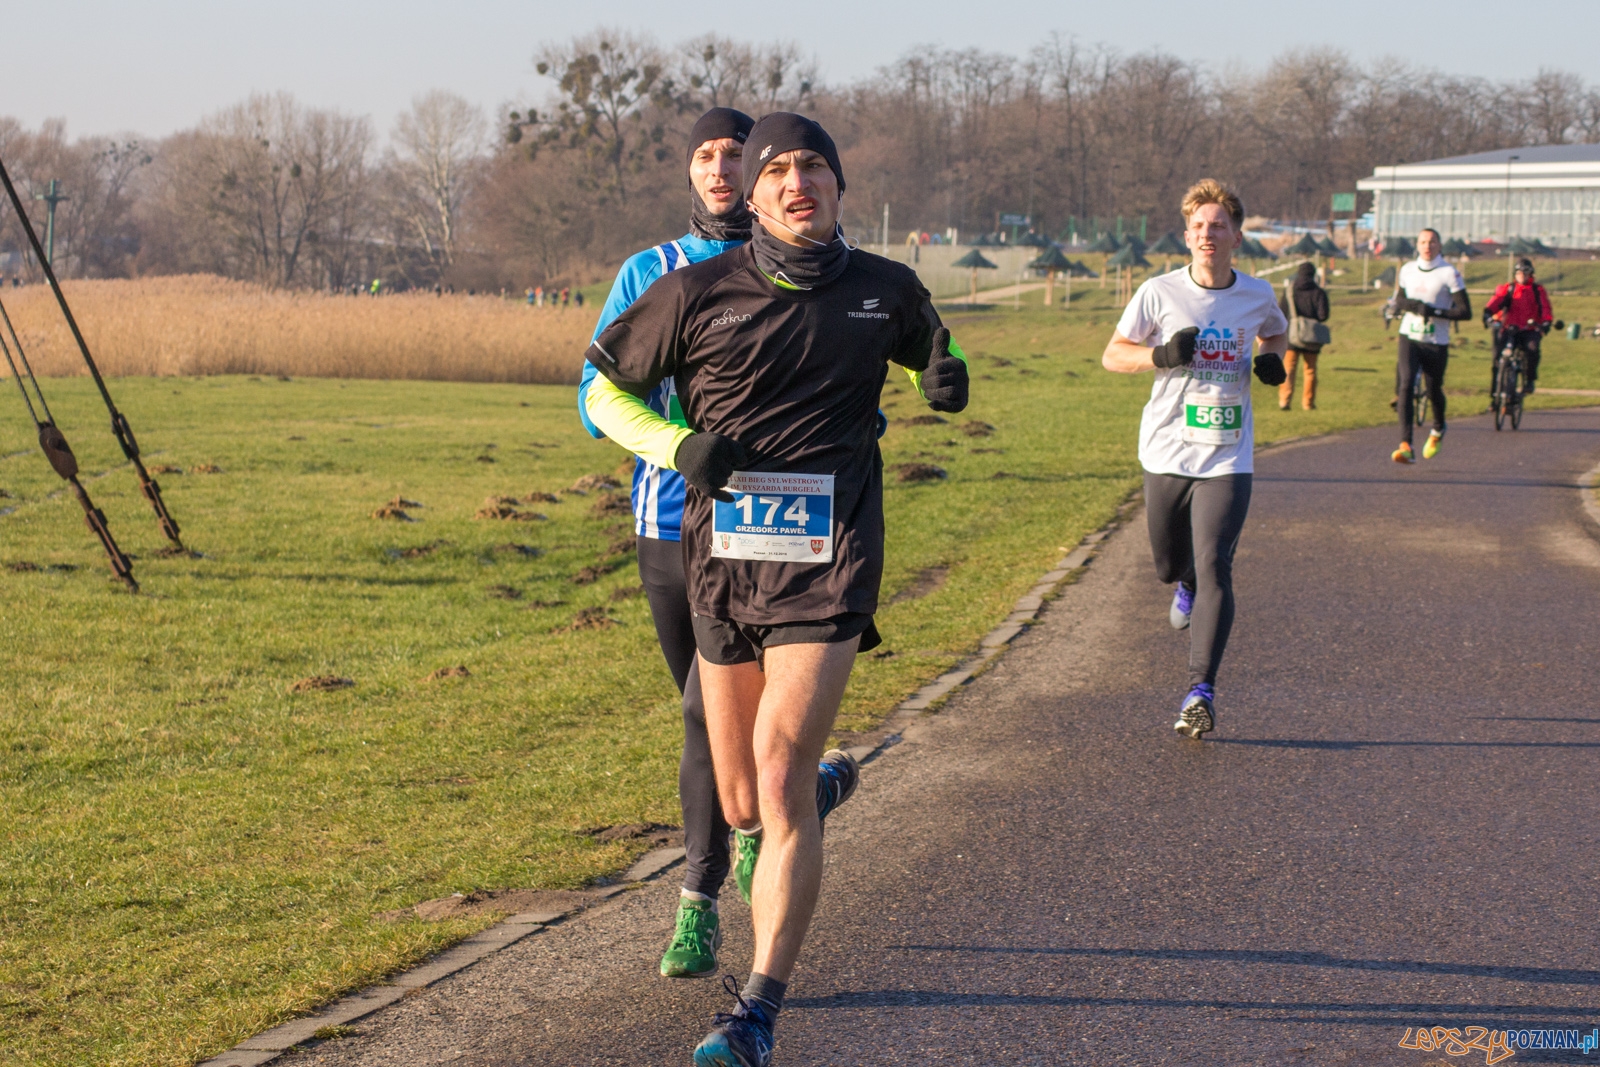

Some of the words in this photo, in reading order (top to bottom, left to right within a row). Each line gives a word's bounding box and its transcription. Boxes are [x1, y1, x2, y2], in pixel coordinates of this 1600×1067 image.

[712, 308, 751, 328] parkrun
[1194, 340, 1237, 351] ARATON
[1195, 406, 1235, 425] 569
[748, 476, 766, 484] BIEG
[767, 477, 824, 485] SYLWESTROWY
[742, 484, 782, 492] RYSZARDA
[783, 485, 821, 493] BURGIELA
[735, 494, 810, 526] 174
[735, 525, 778, 534] GRZEGORZ
[780, 527, 807, 535] PAWEŁ
